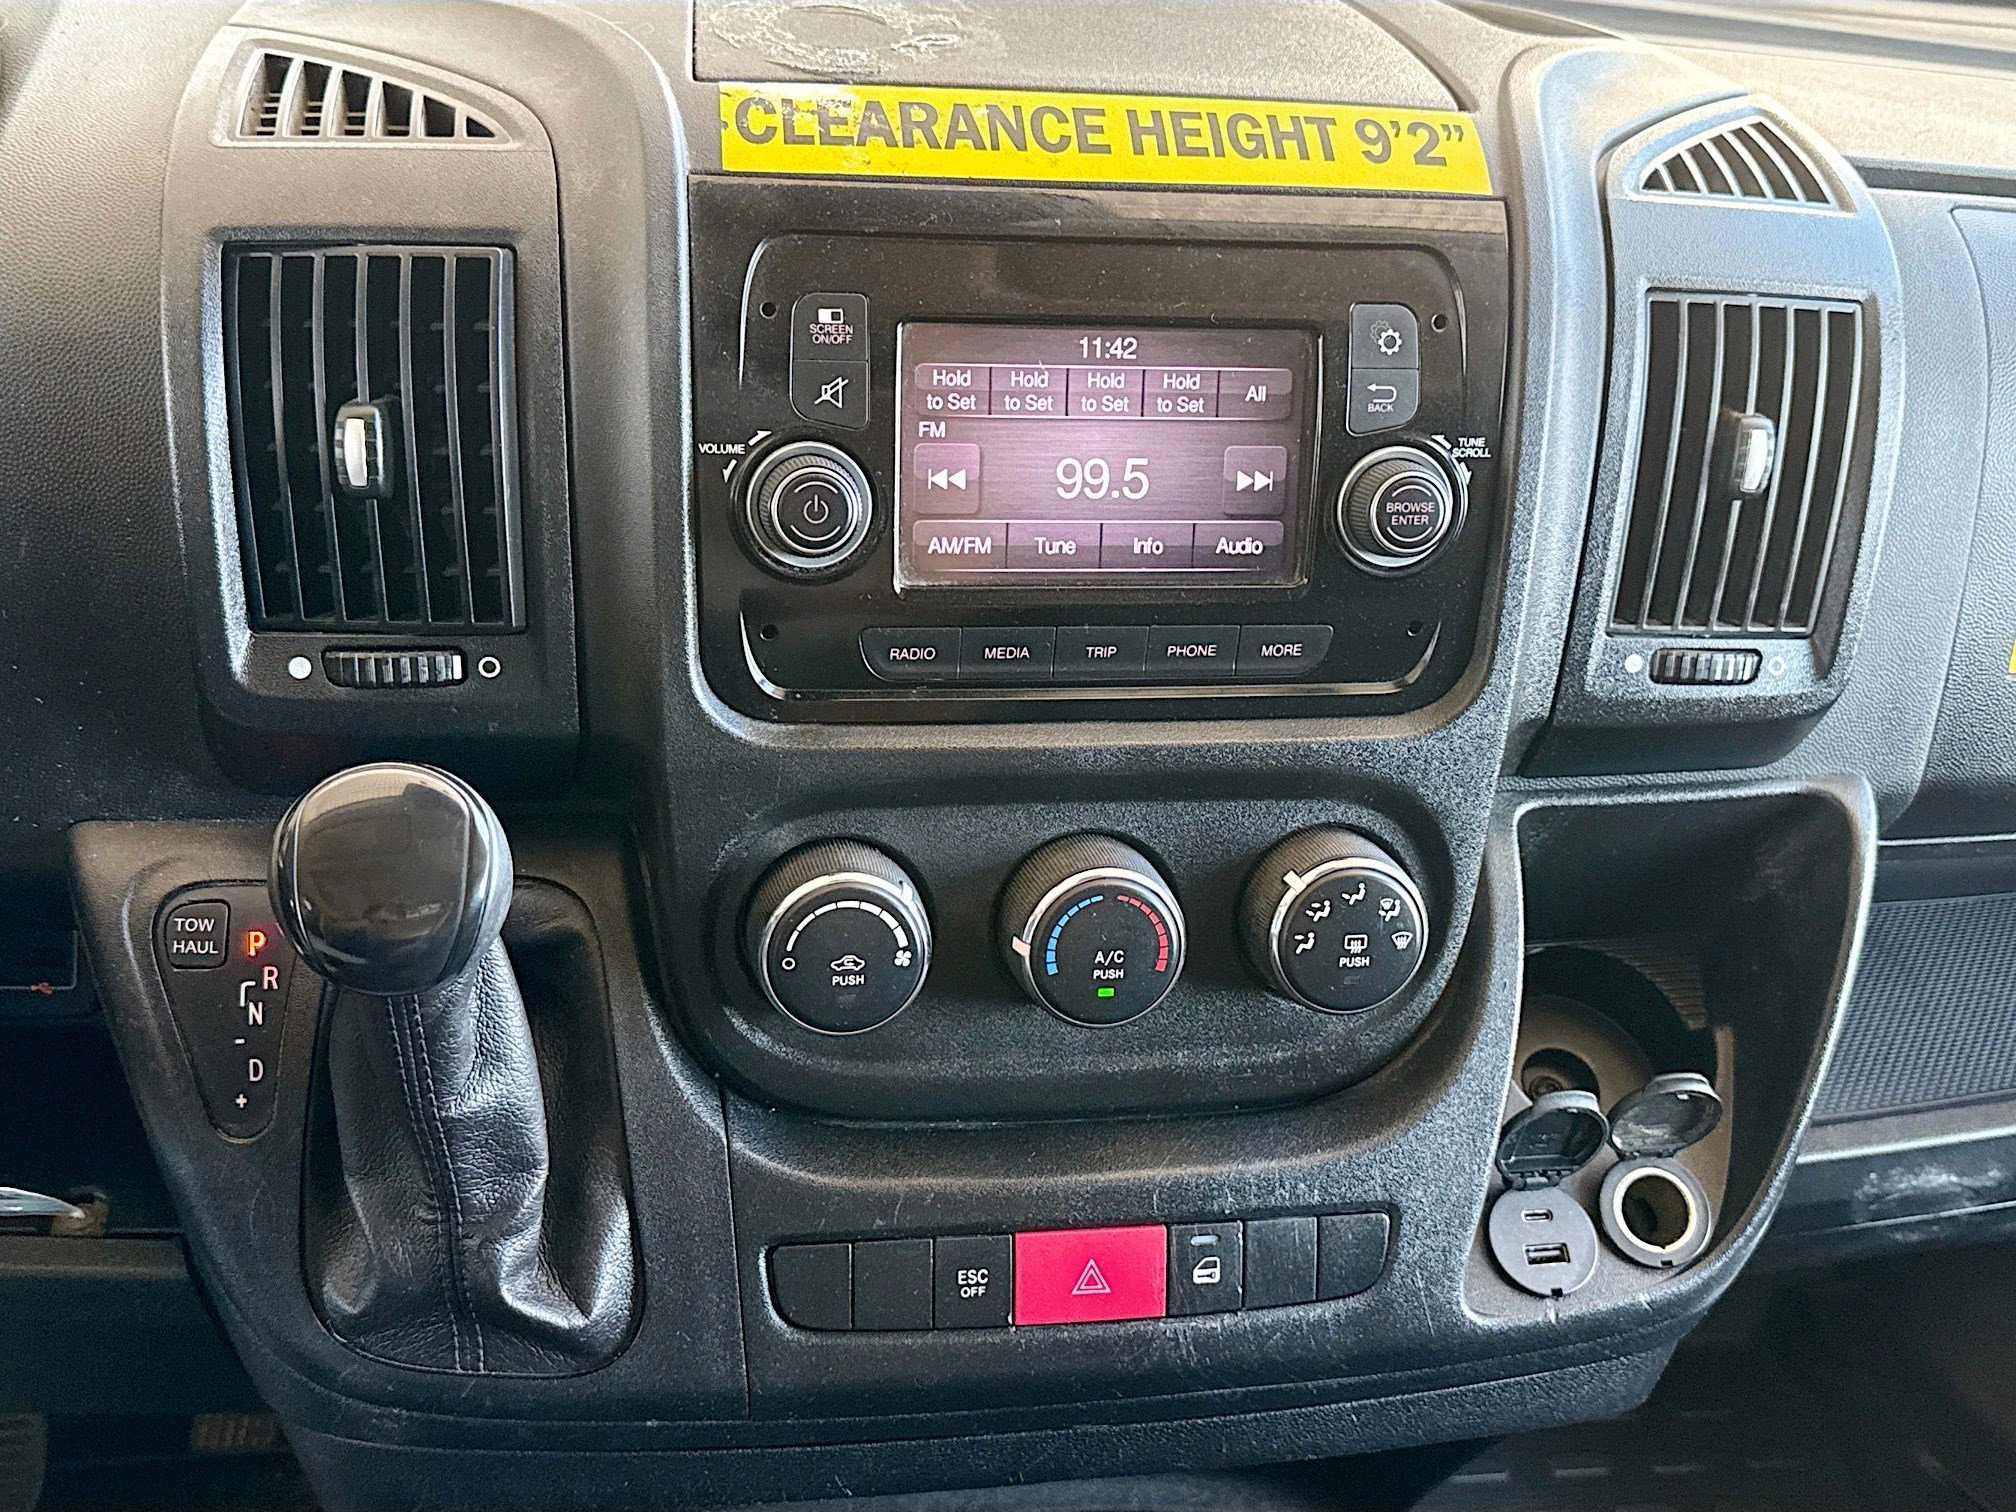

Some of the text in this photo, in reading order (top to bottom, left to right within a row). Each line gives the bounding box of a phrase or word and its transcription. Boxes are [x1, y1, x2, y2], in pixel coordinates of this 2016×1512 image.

[734, 97, 1111, 154] CLEARANCE
[1128, 109, 1337, 163] HEIGHT
[809, 323, 854, 335] SCREEN
[811, 334, 853, 345] ON/OFF
[1079, 336, 1138, 360] 11:42
[932, 369, 972, 387] Hold
[1010, 370, 1049, 388] Hold
[1087, 372, 1125, 389] Hold
[1163, 373, 1201, 390] Hold
[926, 393, 977, 411] to Set
[1244, 385, 1267, 403] All
[1004, 394, 1054, 412] to Set
[1081, 395, 1130, 413] to Set
[1157, 396, 1205, 413] to Set
[1367, 403, 1394, 413] BACK
[918, 421, 947, 438] FM
[698, 443, 747, 455] VOLUME
[1457, 437, 1486, 448] TUNE
[1452, 447, 1492, 459] SCROLL
[1056, 457, 1150, 501] 99.5
[1385, 501, 1436, 514] BROWSE
[1391, 514, 1430, 526] ENTER
[927, 536, 992, 555] AM/FM
[1034, 537, 1077, 555] Tune
[1132, 537, 1164, 555] Info
[1215, 537, 1264, 556] Audio
[889, 646, 936, 661] RADIO
[984, 646, 1030, 660] MEDIA
[1086, 645, 1118, 659] TRIP
[1166, 644, 1218, 658] PHONE
[1260, 643, 1303, 657] MORE
[173, 917, 215, 932] TOW
[172, 940, 219, 955] HAUL
[246, 931, 266, 957] P
[1094, 949, 1125, 965] A/C
[1337, 955, 1371, 968] PUSH
[262, 966, 279, 990] R
[831, 973, 866, 987] PUSH
[1093, 967, 1125, 980] PUSH
[248, 1001, 264, 1026] N
[249, 1059, 264, 1082] D
[957, 1269, 988, 1284] ESC
[961, 1285, 986, 1297] OFF
